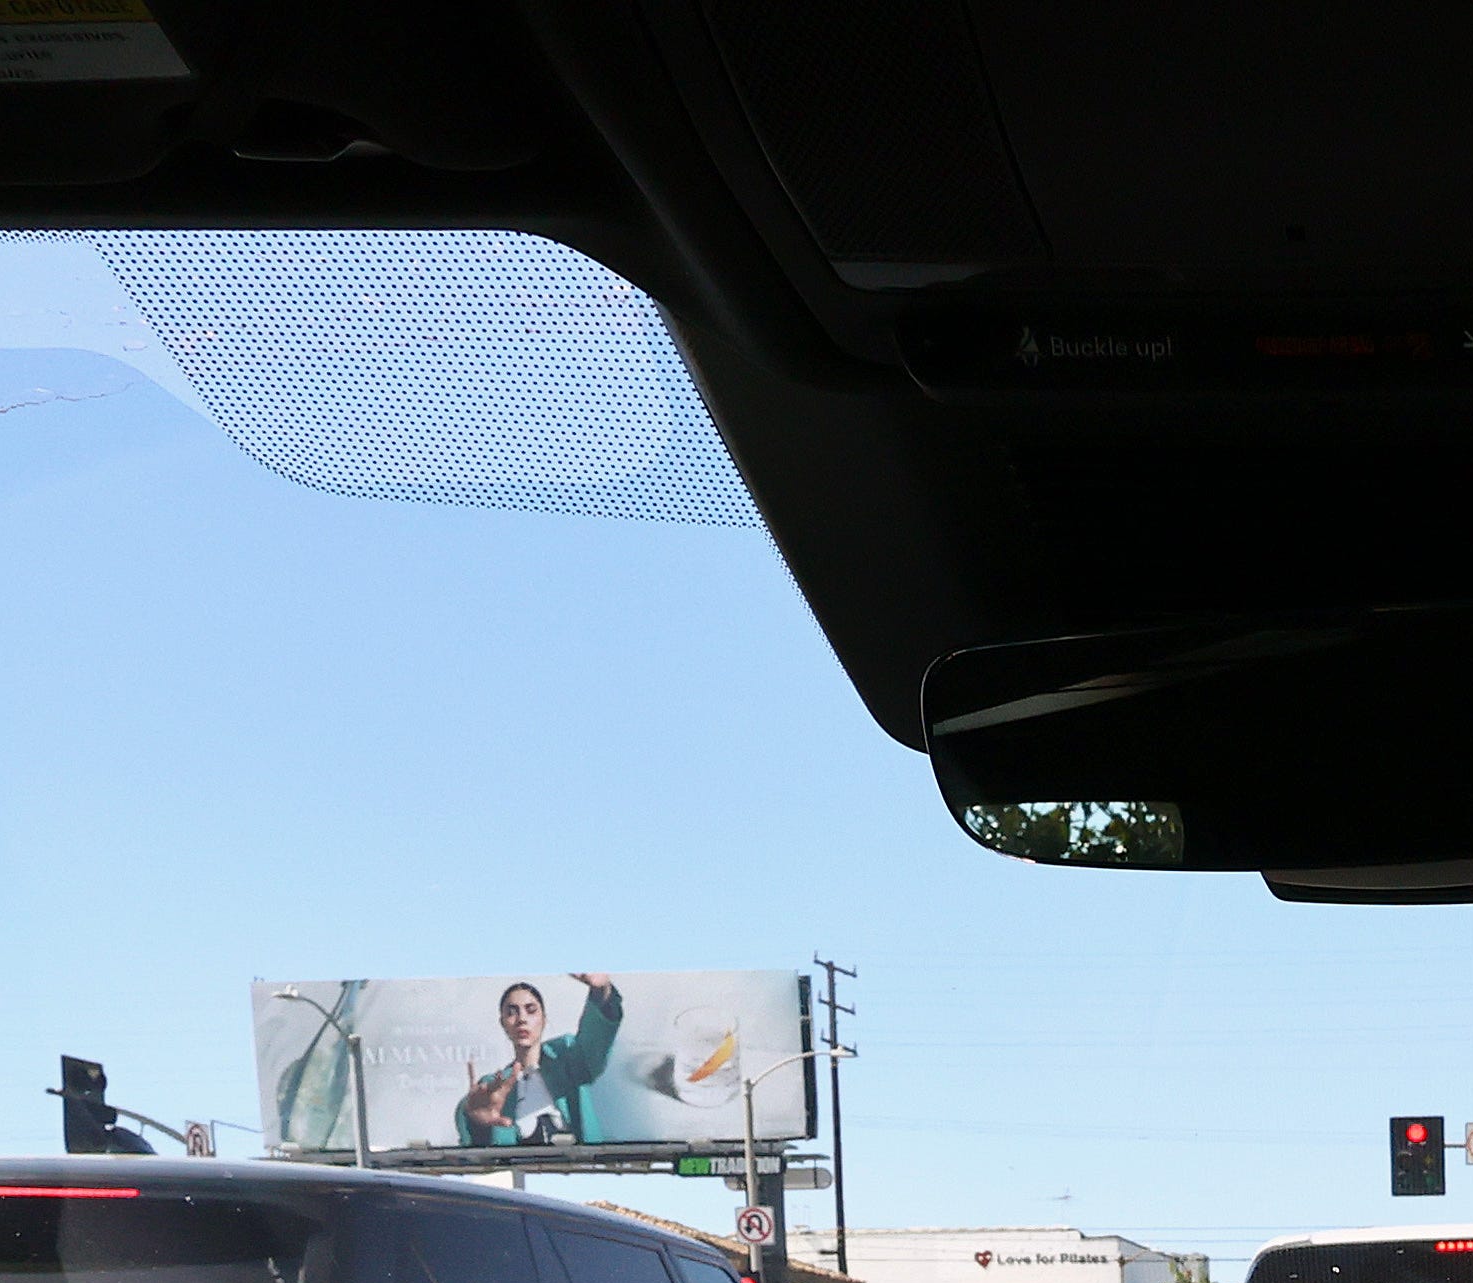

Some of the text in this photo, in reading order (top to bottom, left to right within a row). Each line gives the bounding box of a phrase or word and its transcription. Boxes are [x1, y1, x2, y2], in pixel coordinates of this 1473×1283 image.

[1050, 336, 1173, 362] Buckle up!
[997, 1252, 1109, 1266] Love for Pilates
